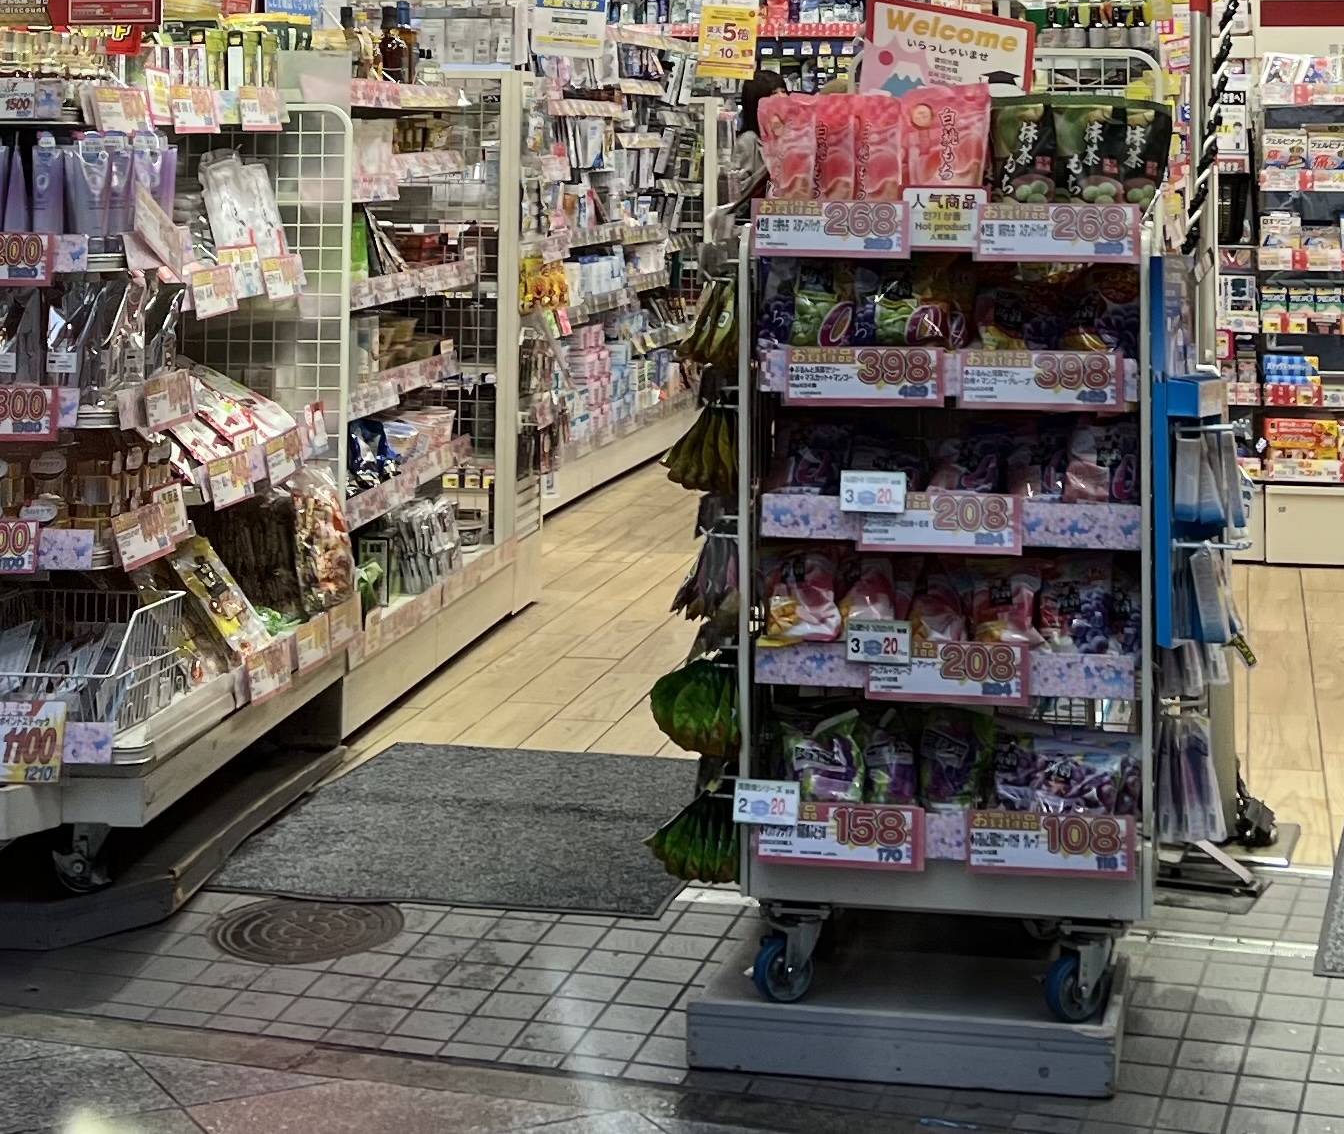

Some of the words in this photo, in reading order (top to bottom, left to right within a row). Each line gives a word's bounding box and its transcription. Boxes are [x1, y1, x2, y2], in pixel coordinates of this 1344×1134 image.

[887, 8, 1018, 53] Welcome
[908, 39, 989, 62] いらっしゃいませ
[1017, 121, 1038, 165] 抹茶
[1083, 122, 1104, 165] 抹茶
[1125, 126, 1146, 167] 抹茶
[760, 201, 822, 216] お買得品
[824, 201, 897, 237] 268
[911, 192, 978, 210] 人气商品
[934, 223, 972, 234] product
[1052, 205, 1129, 241] 268
[857, 348, 932, 384] 398
[1033, 352, 1111, 389] 398
[932, 495, 1009, 531] 208
[882, 636, 899, 655] 20
[940, 643, 1015, 682] 208
[2, 727, 56, 765] 1100
[738, 797, 747, 813] 2
[771, 799, 786, 814] 20
[833, 807, 907, 847] 158
[1043, 816, 1122, 855] 108
